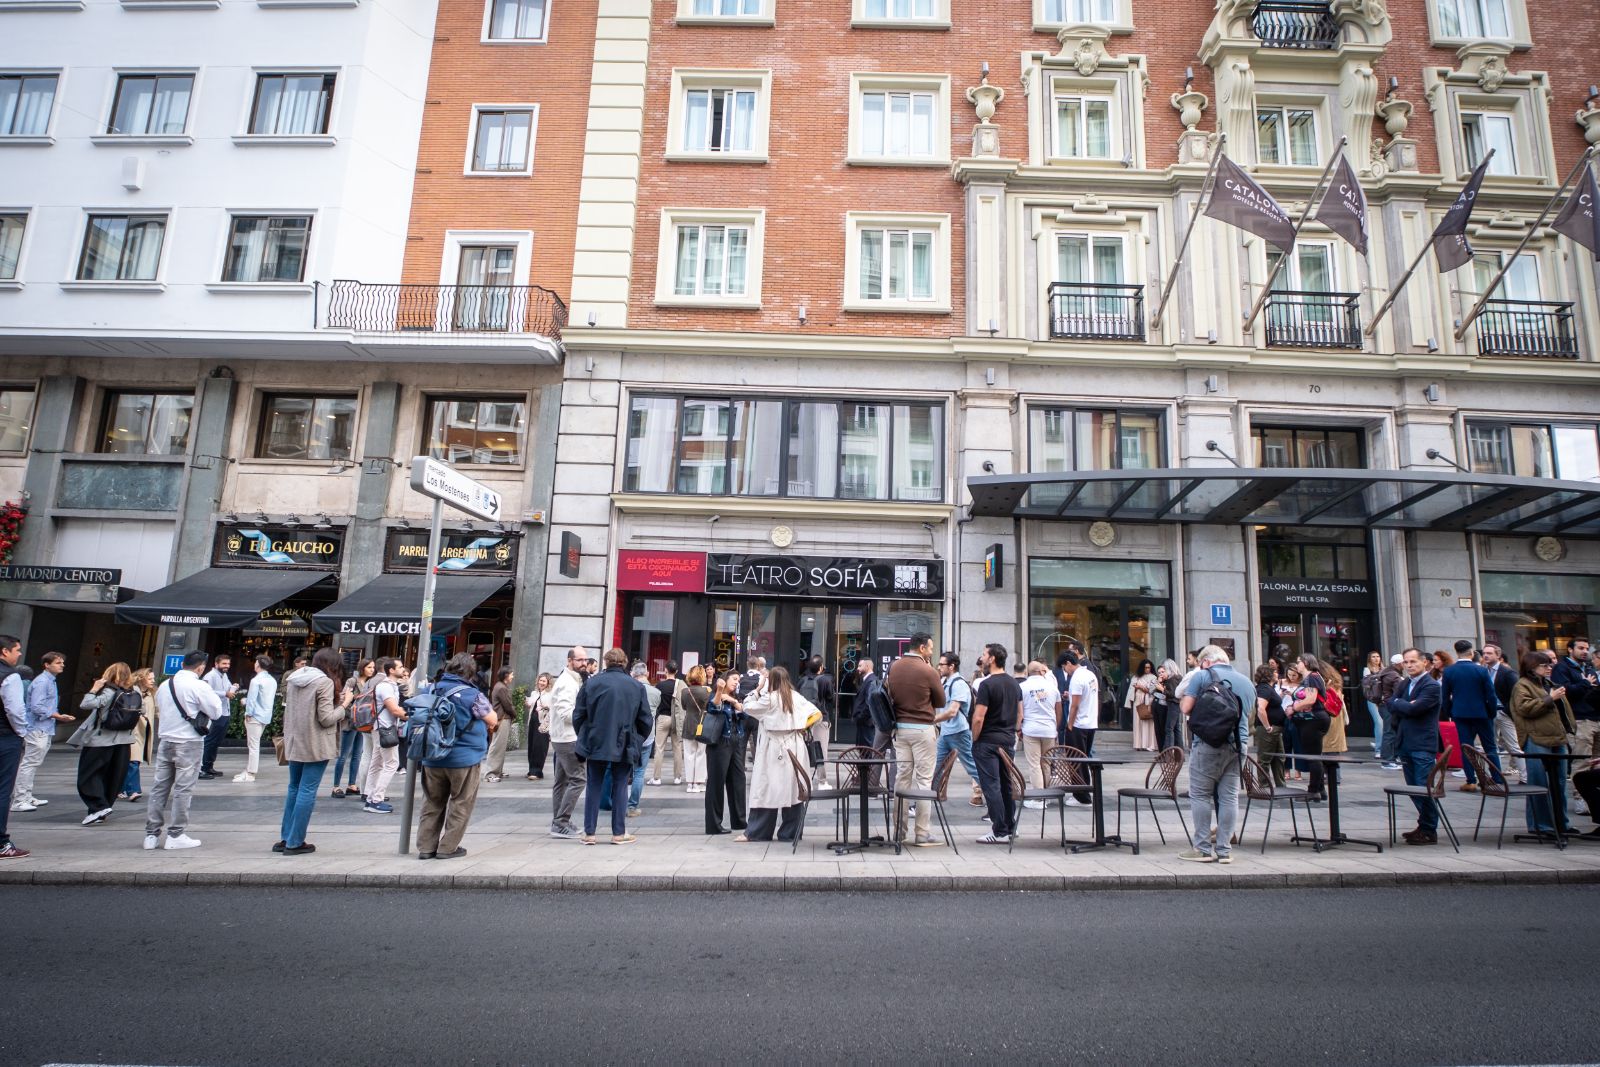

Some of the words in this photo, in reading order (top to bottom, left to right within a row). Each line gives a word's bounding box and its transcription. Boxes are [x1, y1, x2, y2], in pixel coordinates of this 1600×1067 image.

[1232, 194, 1254, 207] HOTELS
[1260, 206, 1282, 223] RESORTS
[1309, 384, 1321, 393] 70
[426, 473, 438, 487] Los
[440, 480, 470, 502] Mostenses
[249, 540, 268, 552] EL
[272, 541, 334, 554] GAUCHO
[399, 545, 429, 557] PARRIL
[441, 548, 487, 560] ARGENTINA
[14, 567, 63, 580] MADRID
[64, 569, 113, 582] CENTRO
[718, 564, 802, 586] TEATRO
[810, 564, 876, 588] SOFÍA
[1258, 582, 1297, 591] TALONIA
[1299, 583, 1330, 592] PLAZA
[1331, 584, 1368, 593] ESPAÑA
[1440, 588, 1452, 597] 70
[1286, 595, 1309, 603] HOTEL
[261, 610, 273, 619] EL
[1216, 606, 1227, 618] H
[160, 614, 183, 623] PARRILLA
[183, 616, 209, 624] ARGENTINA
[340, 621, 361, 634] EL
[364, 621, 422, 634] GAUCH
[170, 657, 180, 668] H
